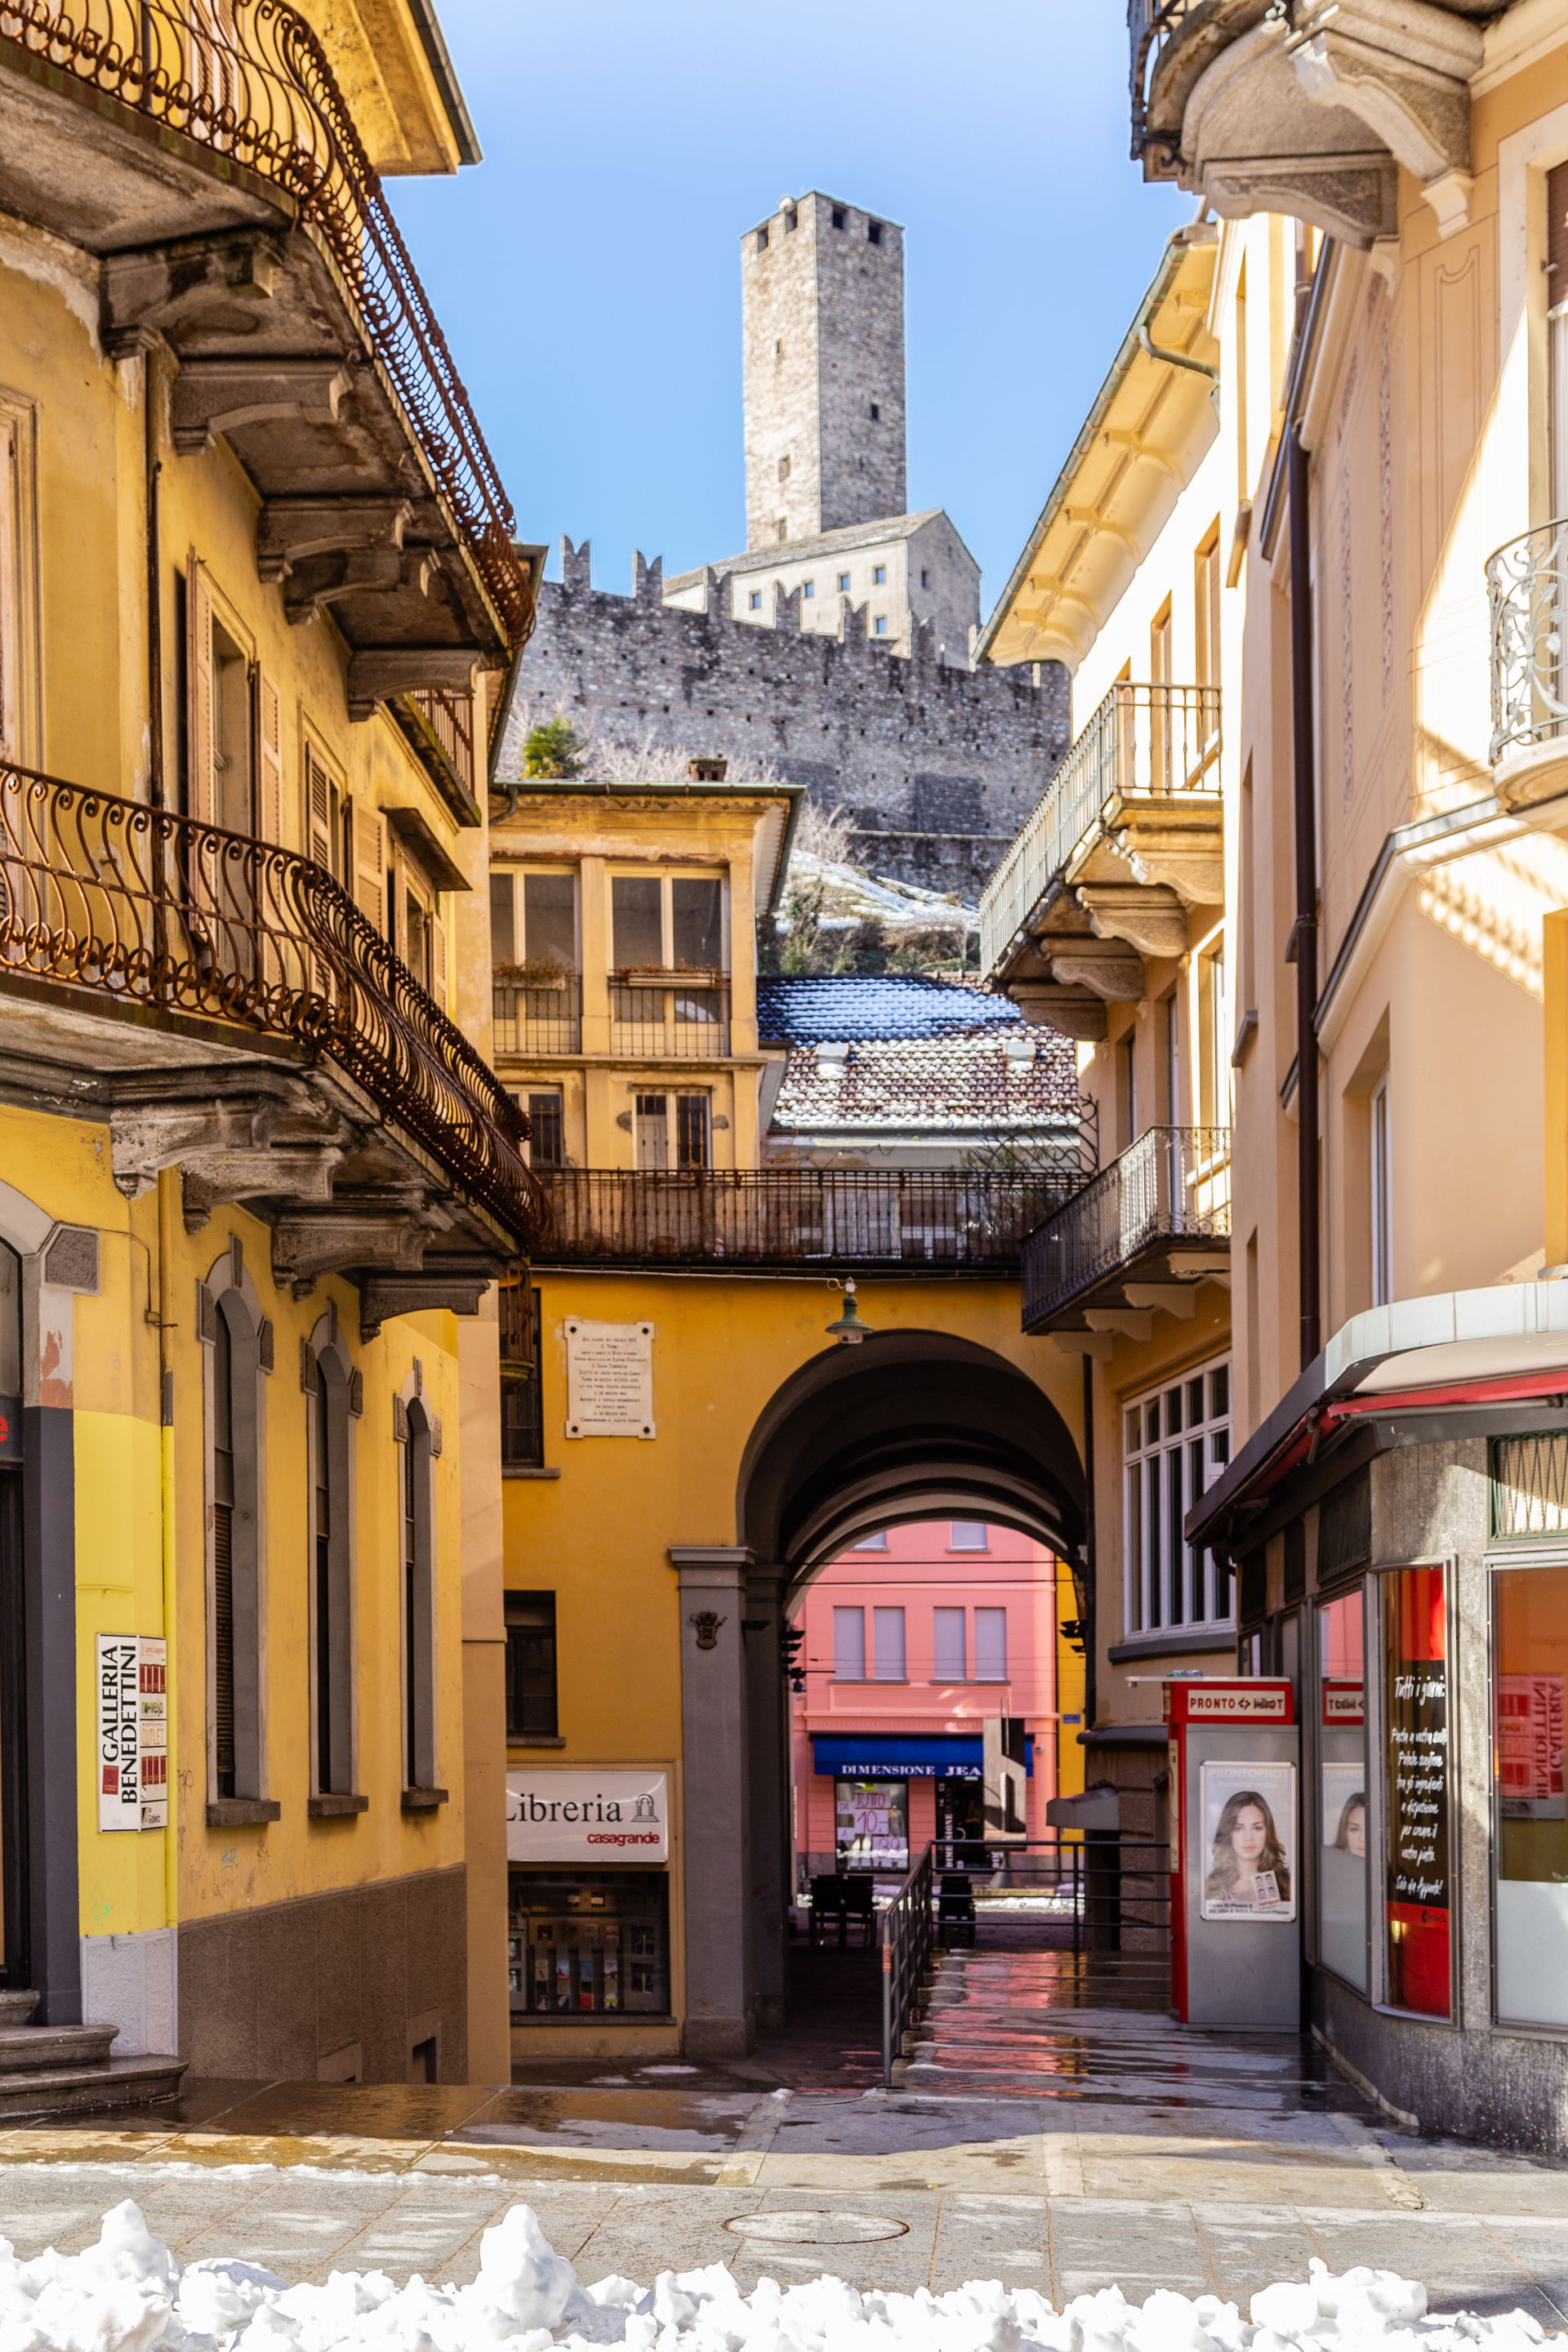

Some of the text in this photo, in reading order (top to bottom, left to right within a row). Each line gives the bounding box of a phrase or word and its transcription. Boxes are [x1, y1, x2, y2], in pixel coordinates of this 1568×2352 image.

[1395, 1675, 1414, 1699] Tutti
[1415, 1677, 1421, 1697] i
[101, 1645, 119, 1762] GALLERIA
[1190, 1698, 1283, 1709] PRONTO POT
[120, 1645, 137, 1803] BENEDETTINI
[842, 1765, 984, 1776] DIMENSIONE JEA
[587, 1832, 660, 1846] casagrande
[945, 1813, 954, 1869] DIMESIONE
[1400, 1824, 1412, 1842] per
